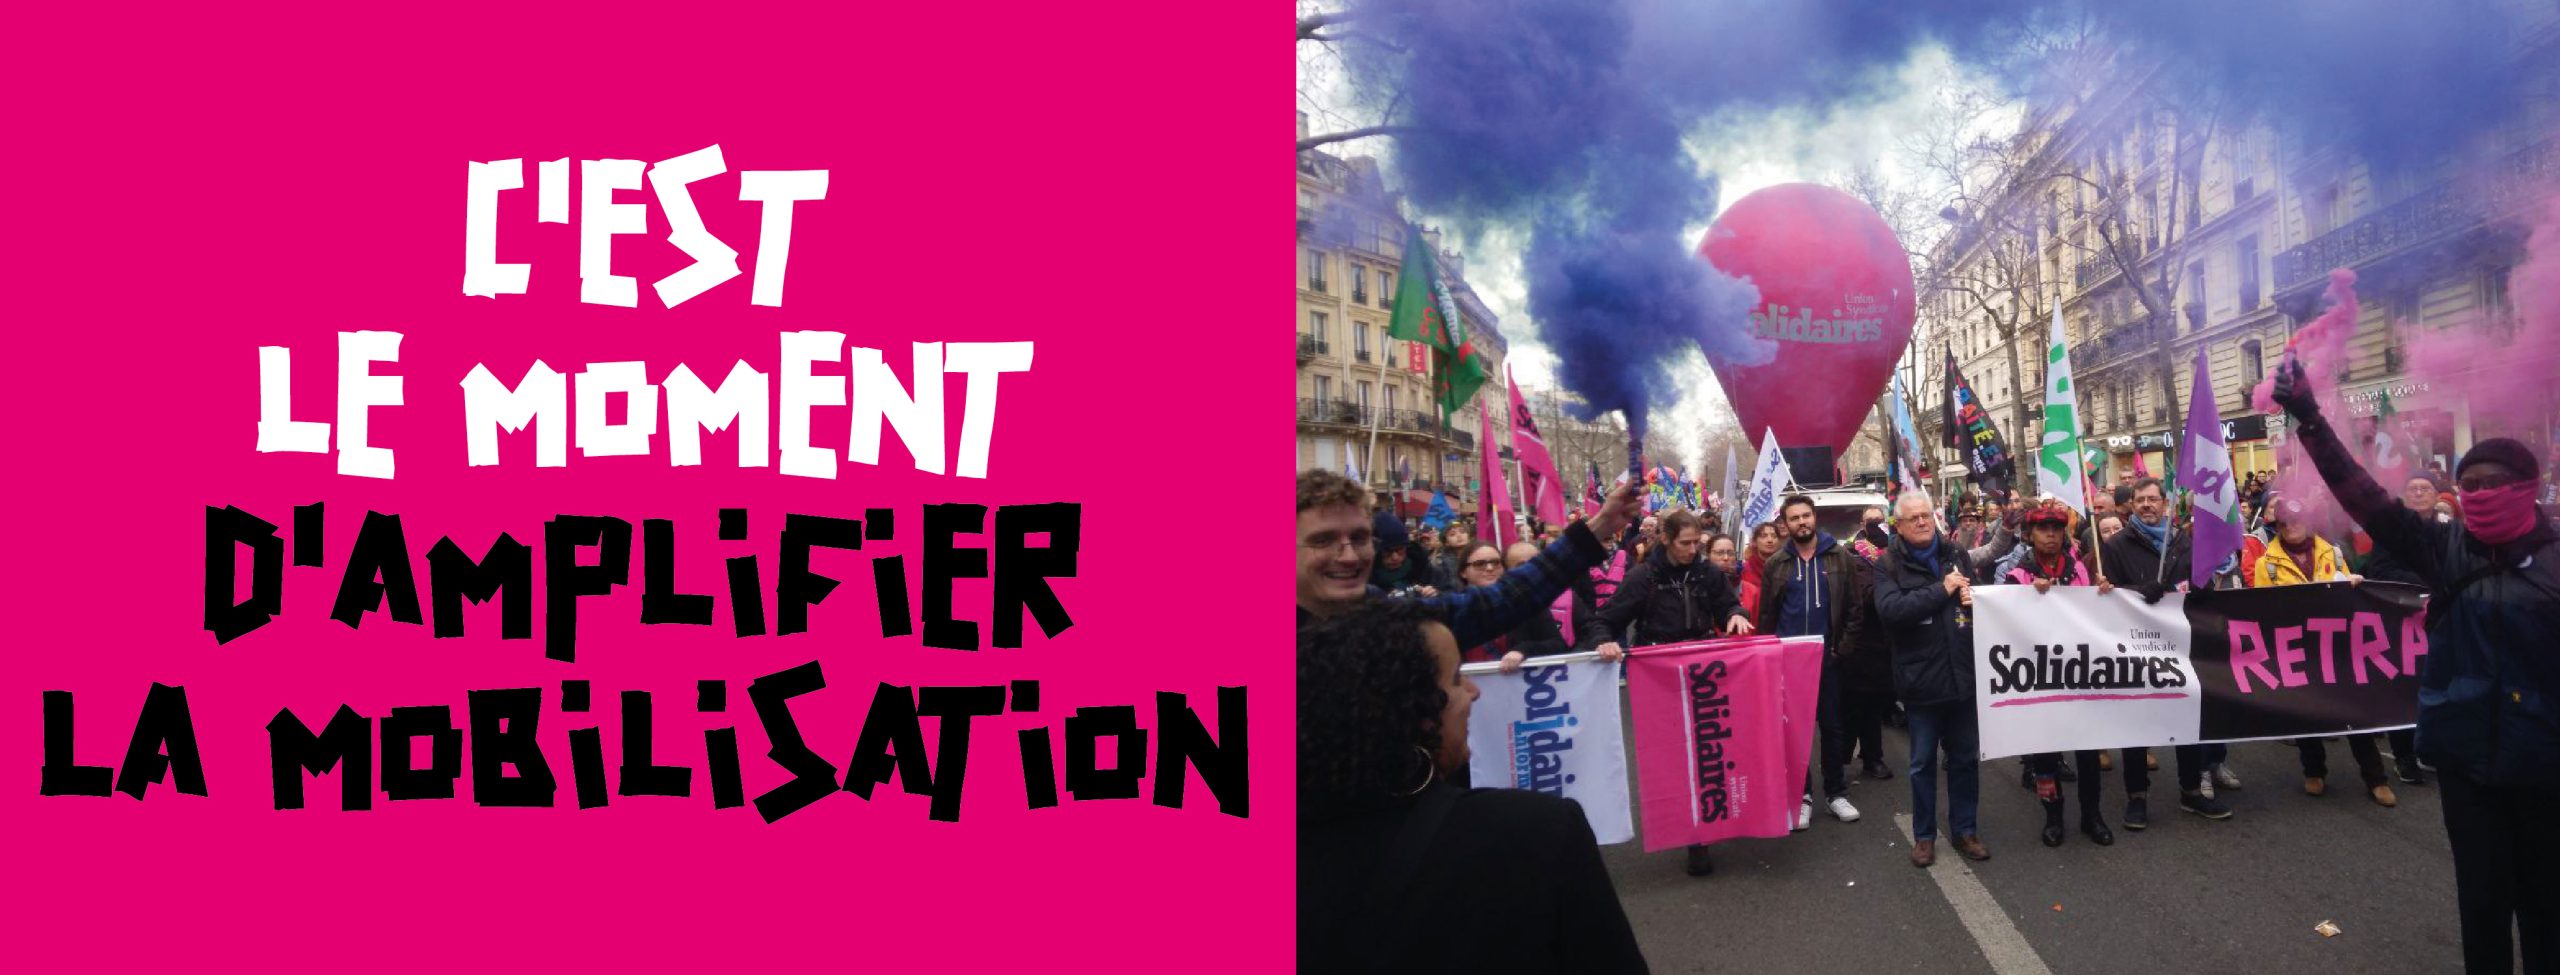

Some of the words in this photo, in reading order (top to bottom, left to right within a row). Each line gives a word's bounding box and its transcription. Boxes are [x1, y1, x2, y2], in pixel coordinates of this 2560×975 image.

[1748, 303, 1882, 344] olidaires
[2130, 628, 2160, 639] Union
[2131, 641, 2177, 654] syndicale
[1989, 643, 2187, 694] Solidaires
[1688, 660, 1735, 824] Solidaires
